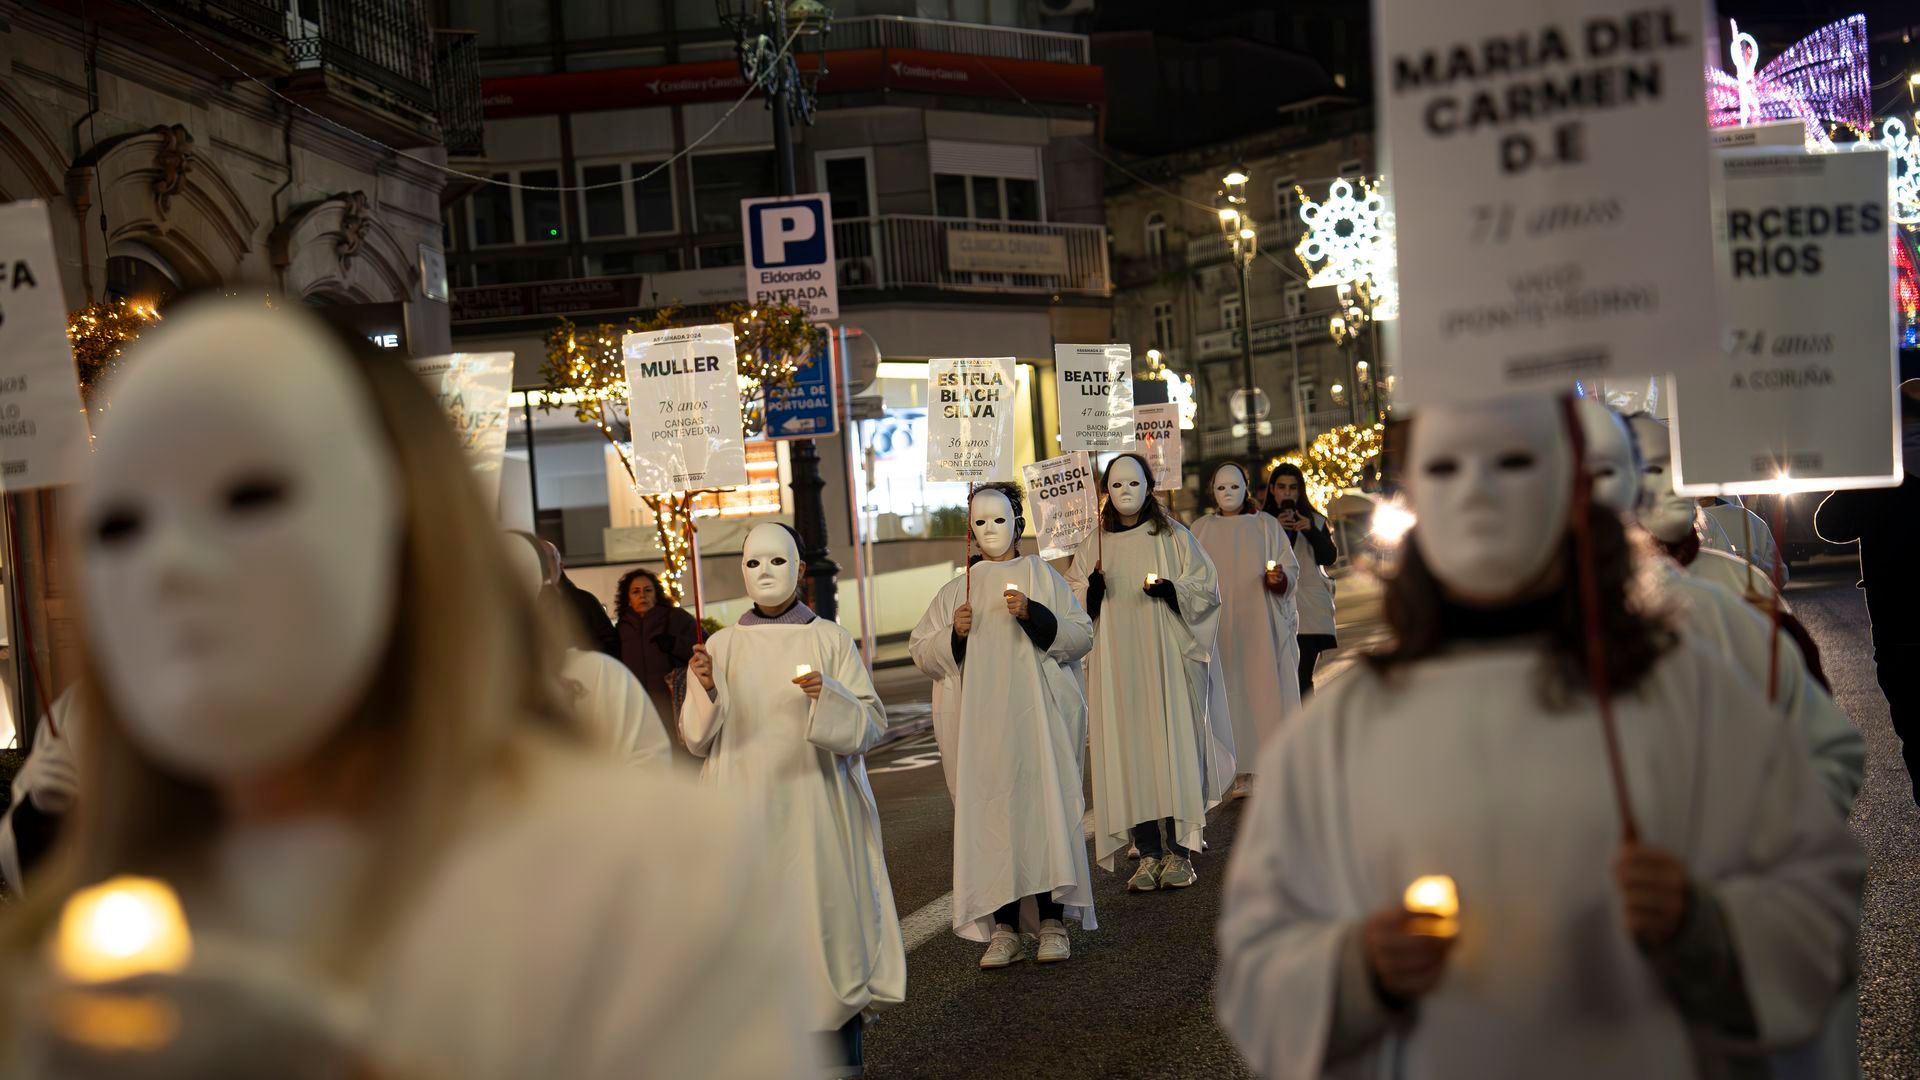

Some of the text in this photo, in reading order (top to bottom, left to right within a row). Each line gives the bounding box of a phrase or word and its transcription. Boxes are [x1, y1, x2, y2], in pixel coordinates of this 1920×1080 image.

[1584, 7, 1692, 57] DEL
[1424, 60, 1662, 137] CARMEN
[760, 268, 821, 285] Eldorado
[757, 286, 827, 303] ENTRADA
[1772, 332, 1835, 359] anos
[641, 356, 719, 378] MULLER
[938, 372, 1003, 386] ESTELA
[810, 386, 826, 396] DE
[941, 389, 999, 402] BLACH
[659, 400, 708, 414] 78 anos
[767, 398, 829, 412] PORTUGAL
[944, 405, 995, 418] SILVA
[1081, 408, 1092, 417] 47
[664, 416, 704, 428] CANGAS
[1135, 420, 1174, 431] ADOUA
[651, 425, 720, 441] (PONTEVEDRA)
[1076, 430, 1123, 438] (PONTEVEDRA)
[948, 437, 961, 448] 36
[1030, 466, 1089, 489] MARISOL
[1040, 479, 1085, 500] COSTA
